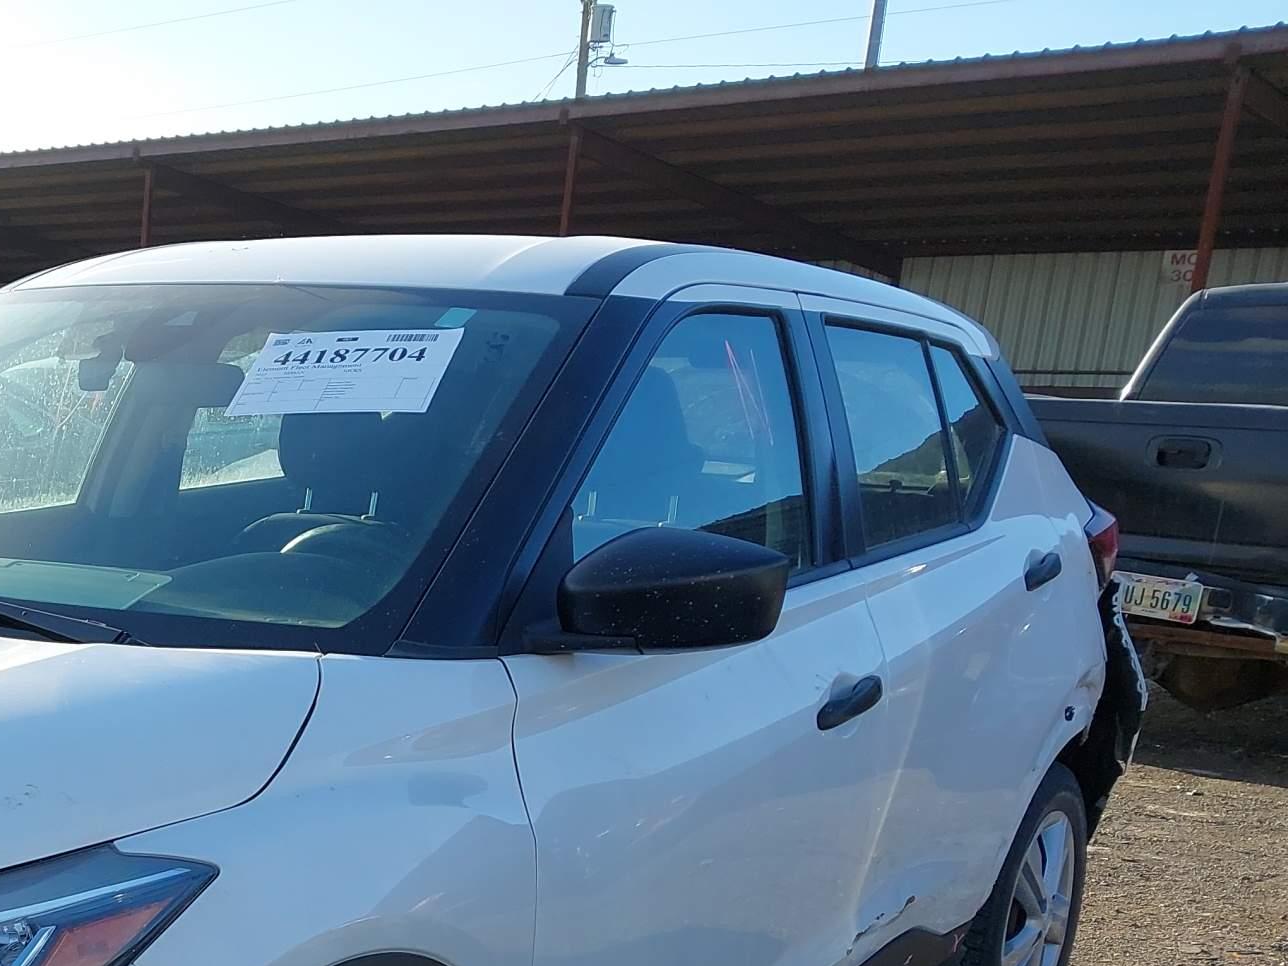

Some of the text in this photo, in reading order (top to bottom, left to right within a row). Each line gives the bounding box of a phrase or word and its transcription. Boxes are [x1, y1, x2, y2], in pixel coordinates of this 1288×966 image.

[274, 347, 426, 366] 44187704
[1124, 585, 1192, 613] UJ 5679
